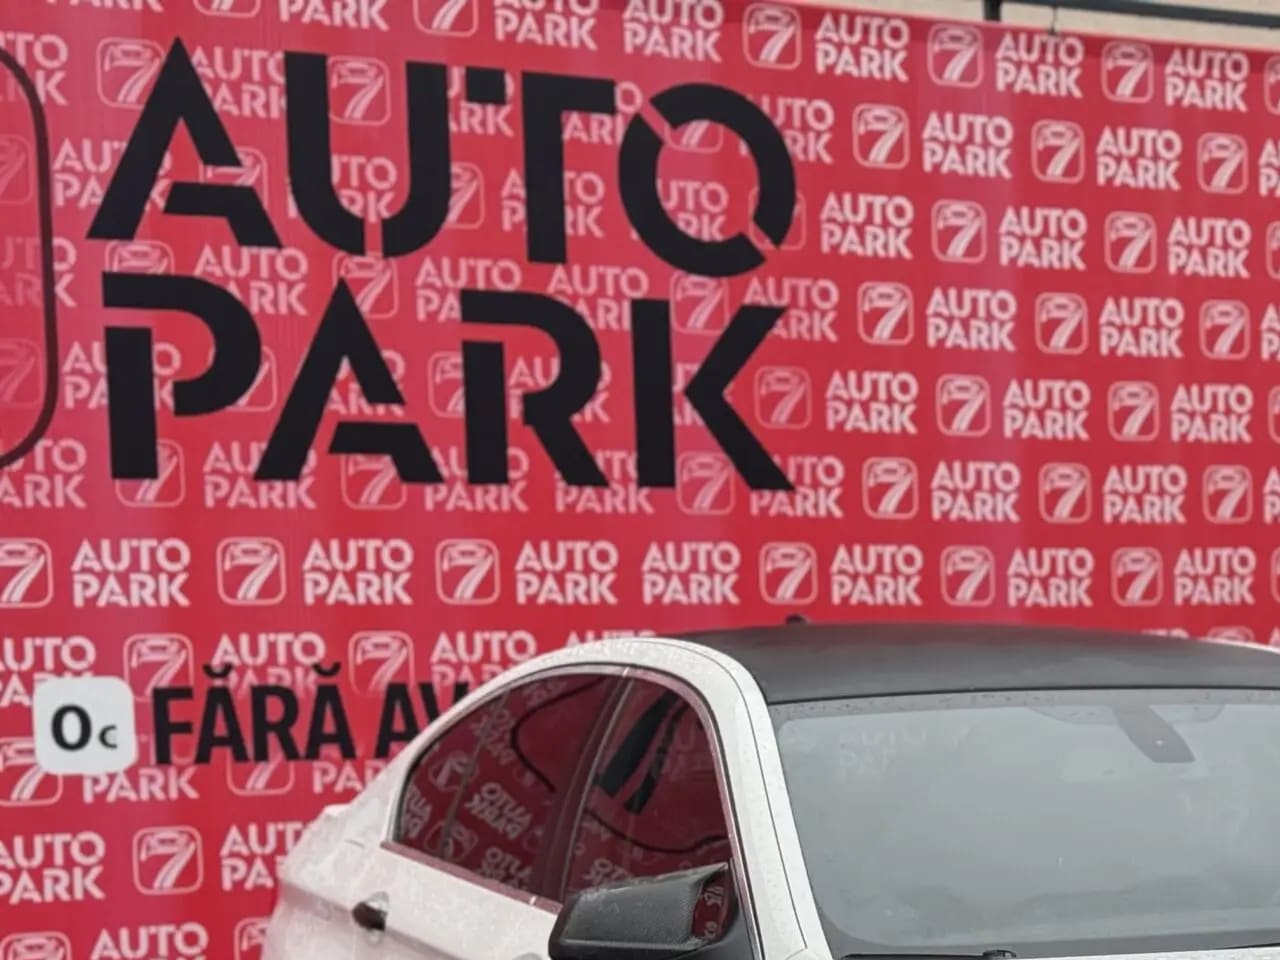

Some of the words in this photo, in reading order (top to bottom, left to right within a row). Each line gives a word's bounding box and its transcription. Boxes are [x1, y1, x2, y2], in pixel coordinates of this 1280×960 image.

[494, 10, 598, 51] PARK
[623, 0, 724, 29] AUTO
[815, 13, 910, 50] AUTO
[624, 21, 721, 62] PARK
[995, 32, 1084, 66] AUTO
[816, 40, 908, 82] PARK
[1165, 49, 1249, 82] AUTO
[996, 60, 1082, 98] PARK
[1165, 75, 1248, 112] PARK
[922, 112, 1013, 148] AUTO
[1096, 126, 1182, 161] AUTO
[87, 36, 798, 277] AUTO
[923, 140, 1012, 179] PARK
[1097, 155, 1181, 191] PARK
[820, 192, 914, 228] AUTO
[999, 206, 1087, 241] AUTO
[821, 222, 912, 260] PARK
[1168, 216, 1251, 249] AUTO
[194, 246, 309, 282] AUTO
[1000, 234, 1086, 270] PARK
[1168, 244, 1250, 278] PARK
[416, 257, 521, 291] AUTO
[547, 265, 650, 299] AUTO
[744, 278, 841, 310] AUTO
[926, 287, 1017, 320] AUTO
[1099, 297, 1184, 329] AUTO
[927, 316, 1015, 352] PARK
[1100, 324, 1183, 358] PARK
[103, 271, 796, 491] PARK
[826, 370, 919, 403] AUTO
[1003, 379, 1091, 409] AUTO
[1170, 384, 1253, 413] AUTO
[827, 399, 917, 434] PARK
[1004, 408, 1089, 440] PARK
[1171, 412, 1252, 443] PARK
[205, 474, 317, 510] PARK
[931, 461, 1021, 491] AUTO
[1103, 465, 1187, 494] AUTO
[424, 481, 529, 514] PARK
[932, 490, 1020, 522] PARK
[1104, 493, 1186, 524] PARK
[71, 538, 191, 572] AUTO
[303, 538, 414, 572] AUTO
[515, 540, 618, 573] AUTO
[642, 542, 741, 573] AUTO
[830, 544, 923, 575] AUTO
[1007, 548, 1094, 579] AUTO
[1174, 547, 1256, 577] AUTO
[73, 571, 190, 608] PARK
[304, 571, 413, 605] PARK
[516, 571, 618, 605] PARK
[643, 572, 740, 605] PARK
[832, 574, 922, 606] PARK
[1008, 577, 1093, 607] PARK
[1174, 575, 1255, 605] PARK
[211, 631, 327, 667] AUTO
[430, 630, 537, 664] AUTO
[152, 661, 356, 765] FĂRĂ
[82, 767, 199, 804] PARK
